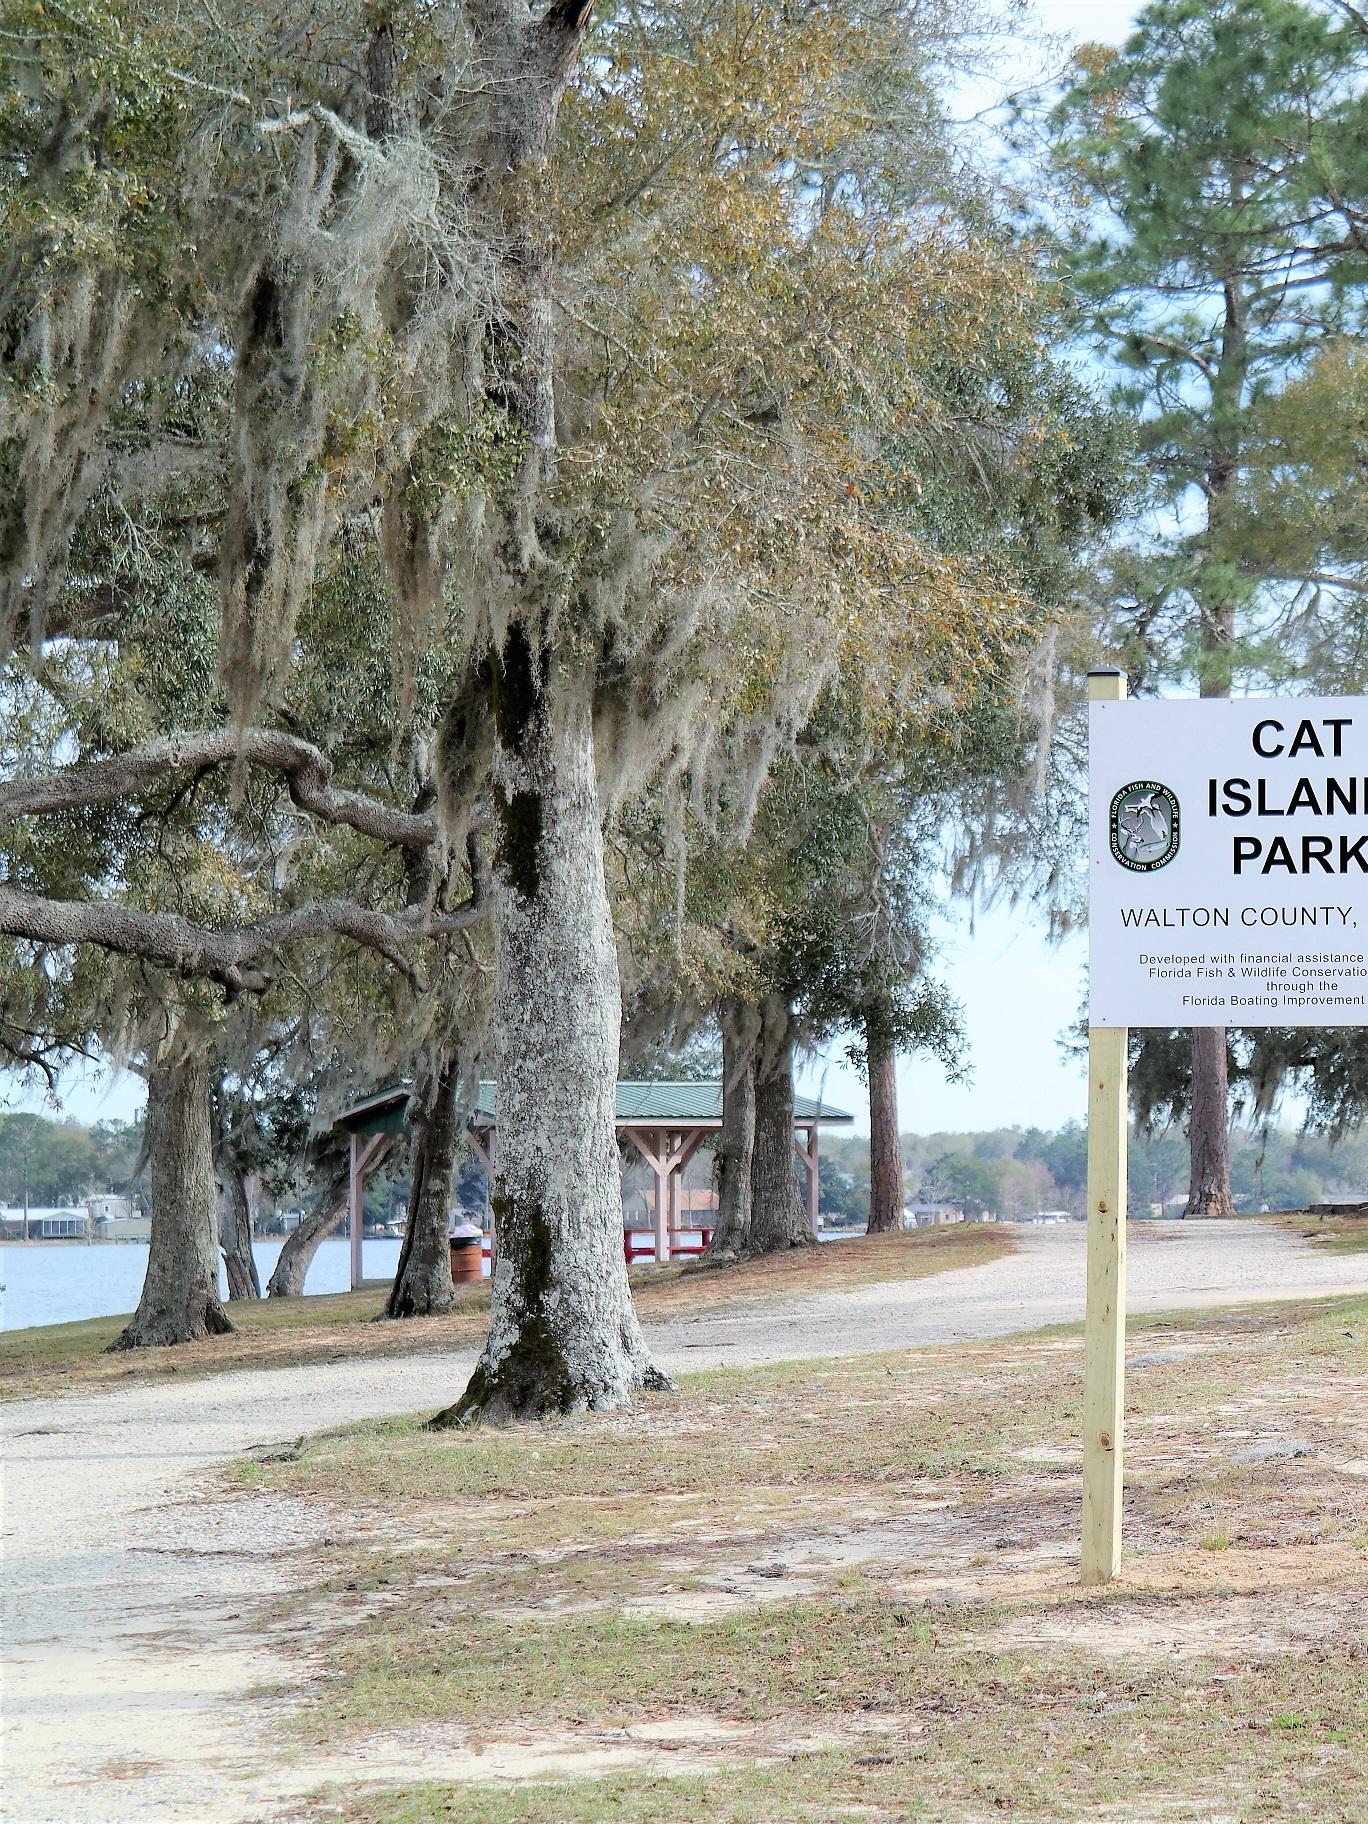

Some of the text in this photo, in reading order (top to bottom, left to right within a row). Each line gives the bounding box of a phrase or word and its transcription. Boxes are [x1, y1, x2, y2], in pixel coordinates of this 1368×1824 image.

[1252, 718, 1353, 759] CAT
[1111, 783, 1178, 818] FLORIDA FISH AND WILDLIFE
[1112, 832, 1178, 870] CONSERVATION COMMISSION
[1120, 907, 1229, 927] WALTON
[1240, 906, 1357, 929] COUNTY,
[1139, 953, 1205, 966] Developed
[1210, 953, 1235, 964] with
[1239, 952, 1292, 964] financial
[1297, 953, 1364, 963] assistance
[1149, 967, 1192, 978] Florida
[1197, 967, 1223, 978] Fish
[1227, 967, 1236, 978] &
[1240, 967, 1287, 978] Wildlife
[1266, 980, 1339, 993] through the
[1183, 995, 1226, 1006] Florida
[1230, 995, 1278, 1008] Boating
[1283, 995, 1365, 1008] Improvement
